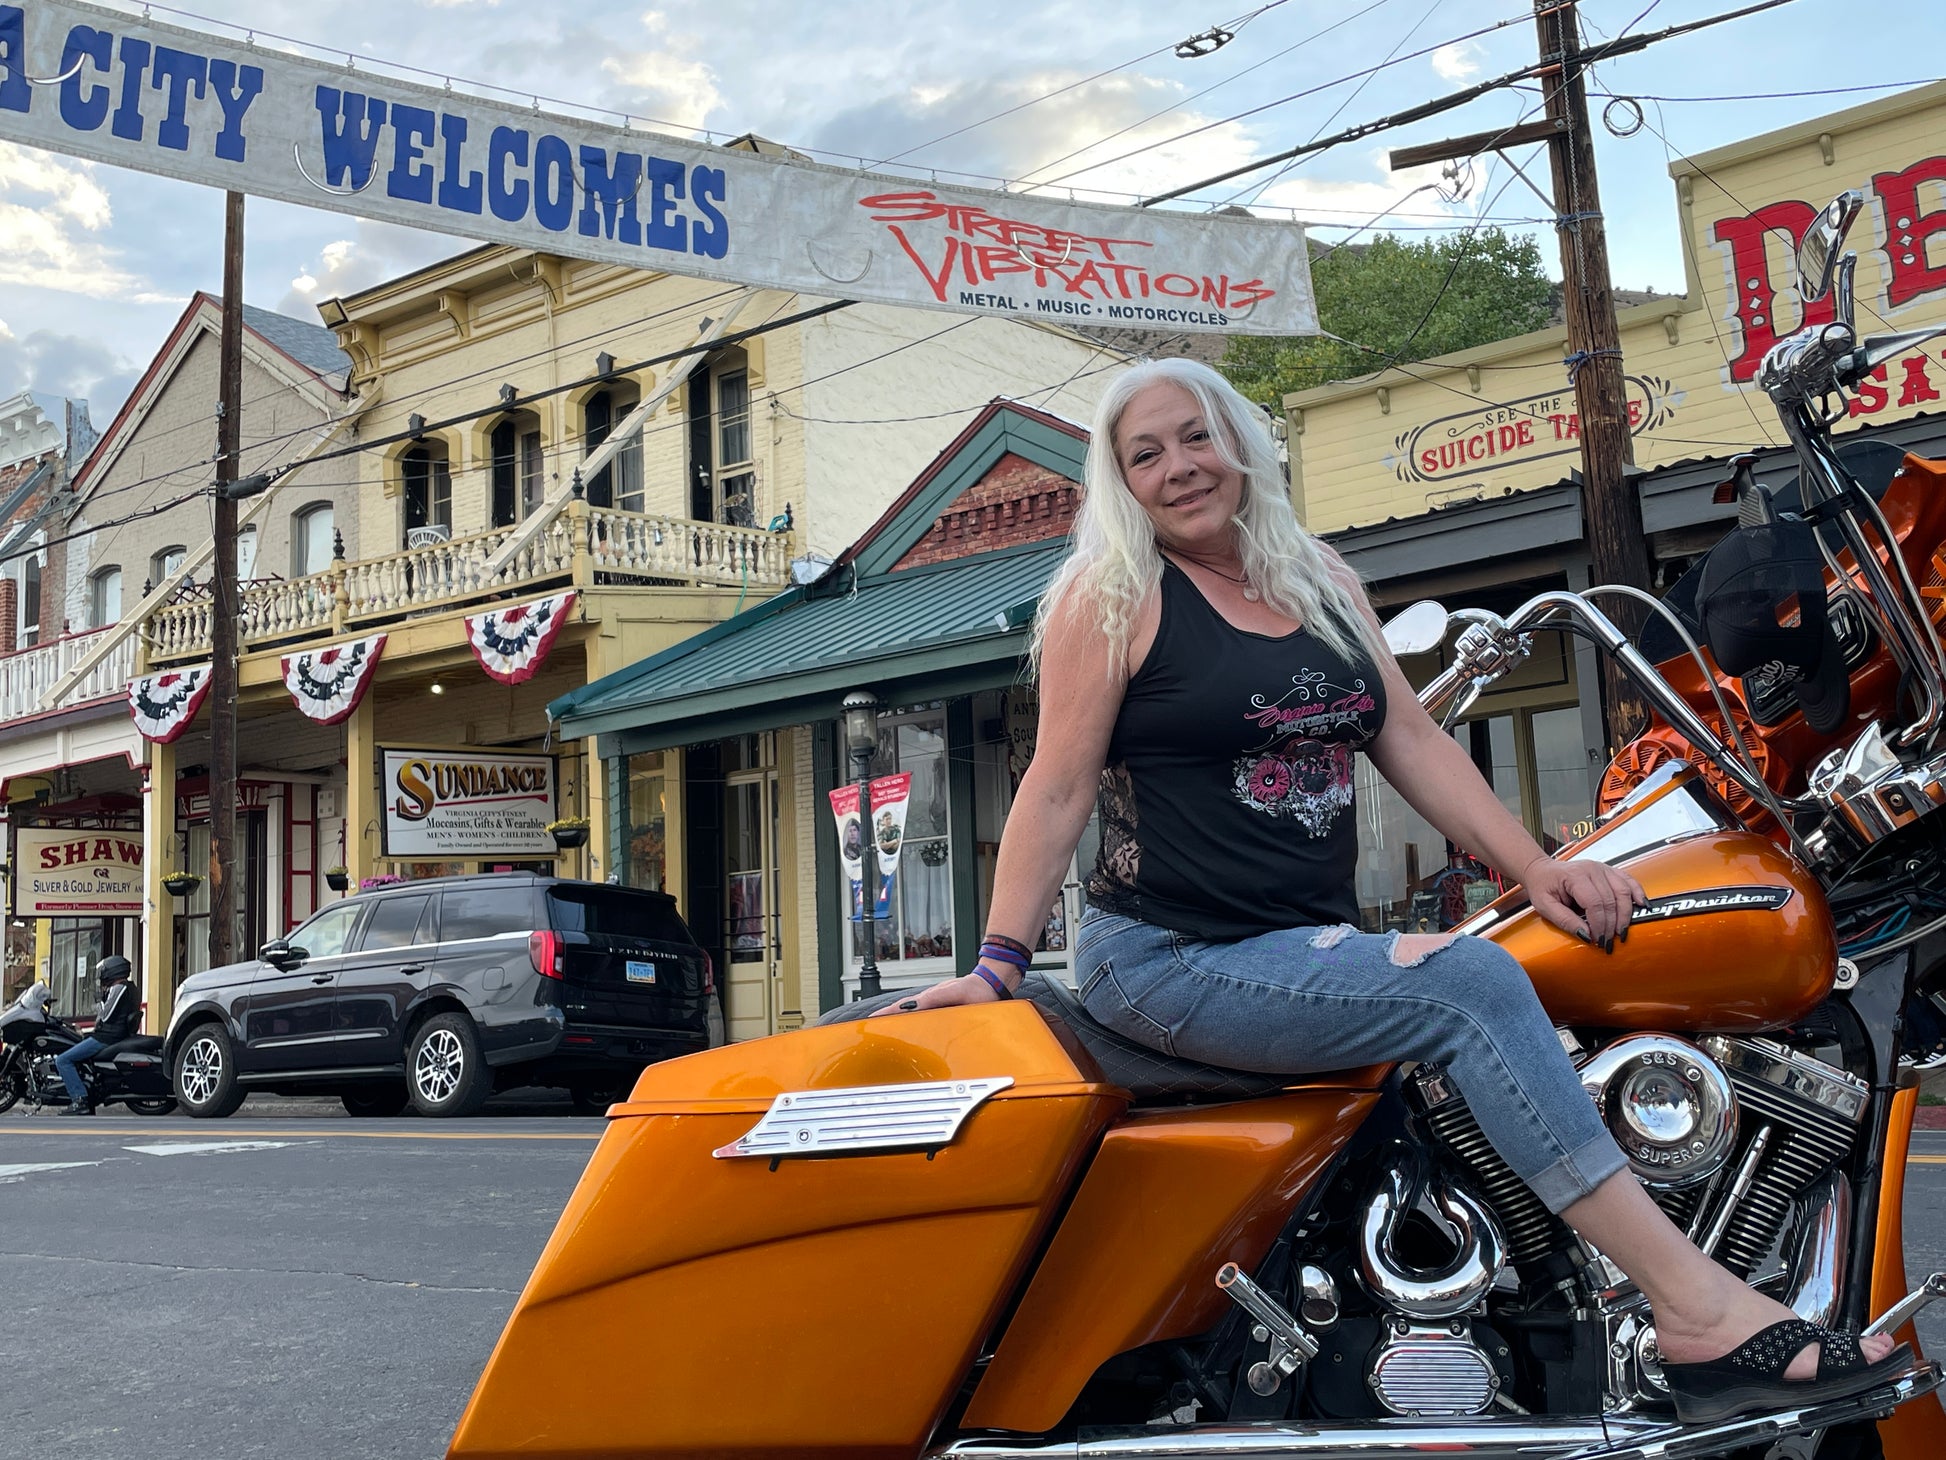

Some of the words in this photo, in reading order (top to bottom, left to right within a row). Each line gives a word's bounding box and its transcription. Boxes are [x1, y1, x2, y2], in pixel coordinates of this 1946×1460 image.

[59, 24, 263, 162] CITY
[316, 85, 728, 259] WELCOMES
[860, 191, 1153, 260] STREET
[888, 224, 1275, 308] VIBRATIONS
[960, 291, 1017, 310] METAL
[1037, 299, 1091, 316] MUSIC
[1108, 304, 1228, 326] MOTORCYCLES
[1849, 349, 1946, 418] SA
[1485, 407, 1517, 426] SEE
[1529, 397, 1561, 416] THE
[1421, 419, 1535, 473] SUICIDE
[1547, 400, 1642, 440] TAE
[1276, 710, 1359, 735] MOTORCYCLE
[1308, 725, 1331, 737] CO.
[396, 758, 547, 821] SUNDANCE
[445, 809, 478, 817] VIRGINIA
[502, 810, 527, 818] FINEST
[474, 817, 494, 829] Gifts
[496, 819, 503, 829] &
[505, 817, 546, 829] Wearables
[427, 831, 452, 839] MEN'S
[457, 831, 496, 839] WOMEN'S
[500, 831, 548, 839] CHILDREN'S
[40, 838, 144, 869] SHAW
[33, 879, 62, 893] SILVER
[63, 880, 69, 892] &
[71, 880, 92, 893] GOLD
[96, 880, 131, 893] JEWELRY
[1641, 1051, 1677, 1066] S&S
[1639, 1143, 1692, 1165] SUPER
